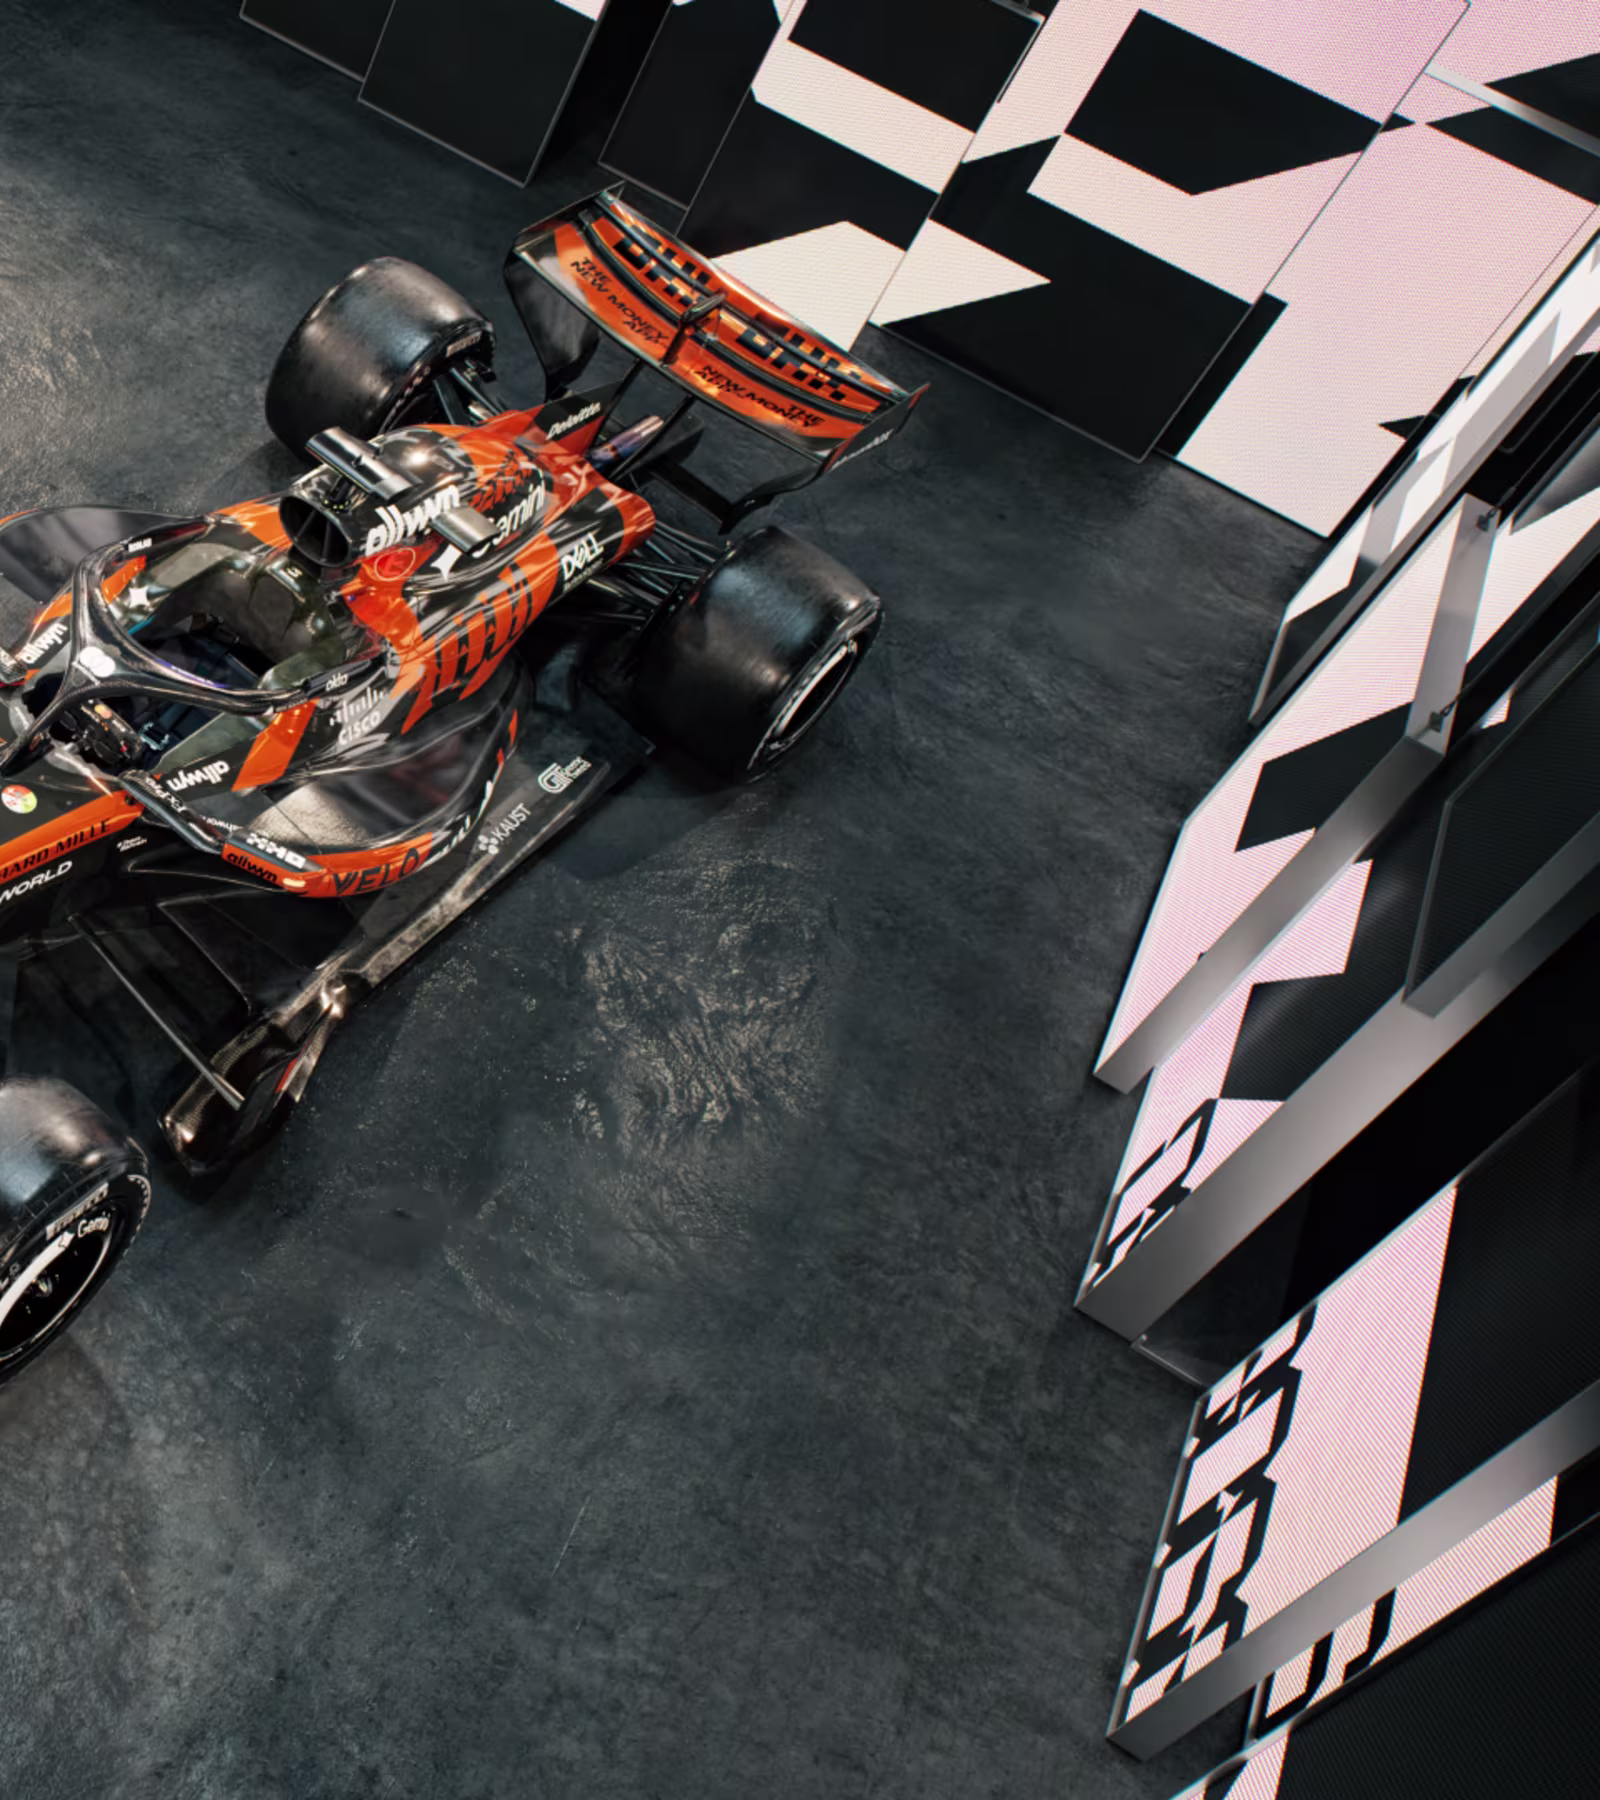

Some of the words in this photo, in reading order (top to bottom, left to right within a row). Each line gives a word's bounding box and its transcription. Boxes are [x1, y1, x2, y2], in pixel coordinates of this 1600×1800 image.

[581, 257, 611, 283] THE
[570, 261, 609, 292] NEW
[607, 294, 670, 340] MONEY
[561, 532, 604, 581] DELL
[19, 622, 68, 664] allwyn
[325, 671, 349, 692] okta
[167, 761, 230, 792] allwyn
[56, 818, 111, 853] MILLE
[492, 803, 531, 841] KAUST
[227, 852, 278, 884] allwyn
[247, 832, 306, 869] OKX
[333, 847, 419, 895] VELO
